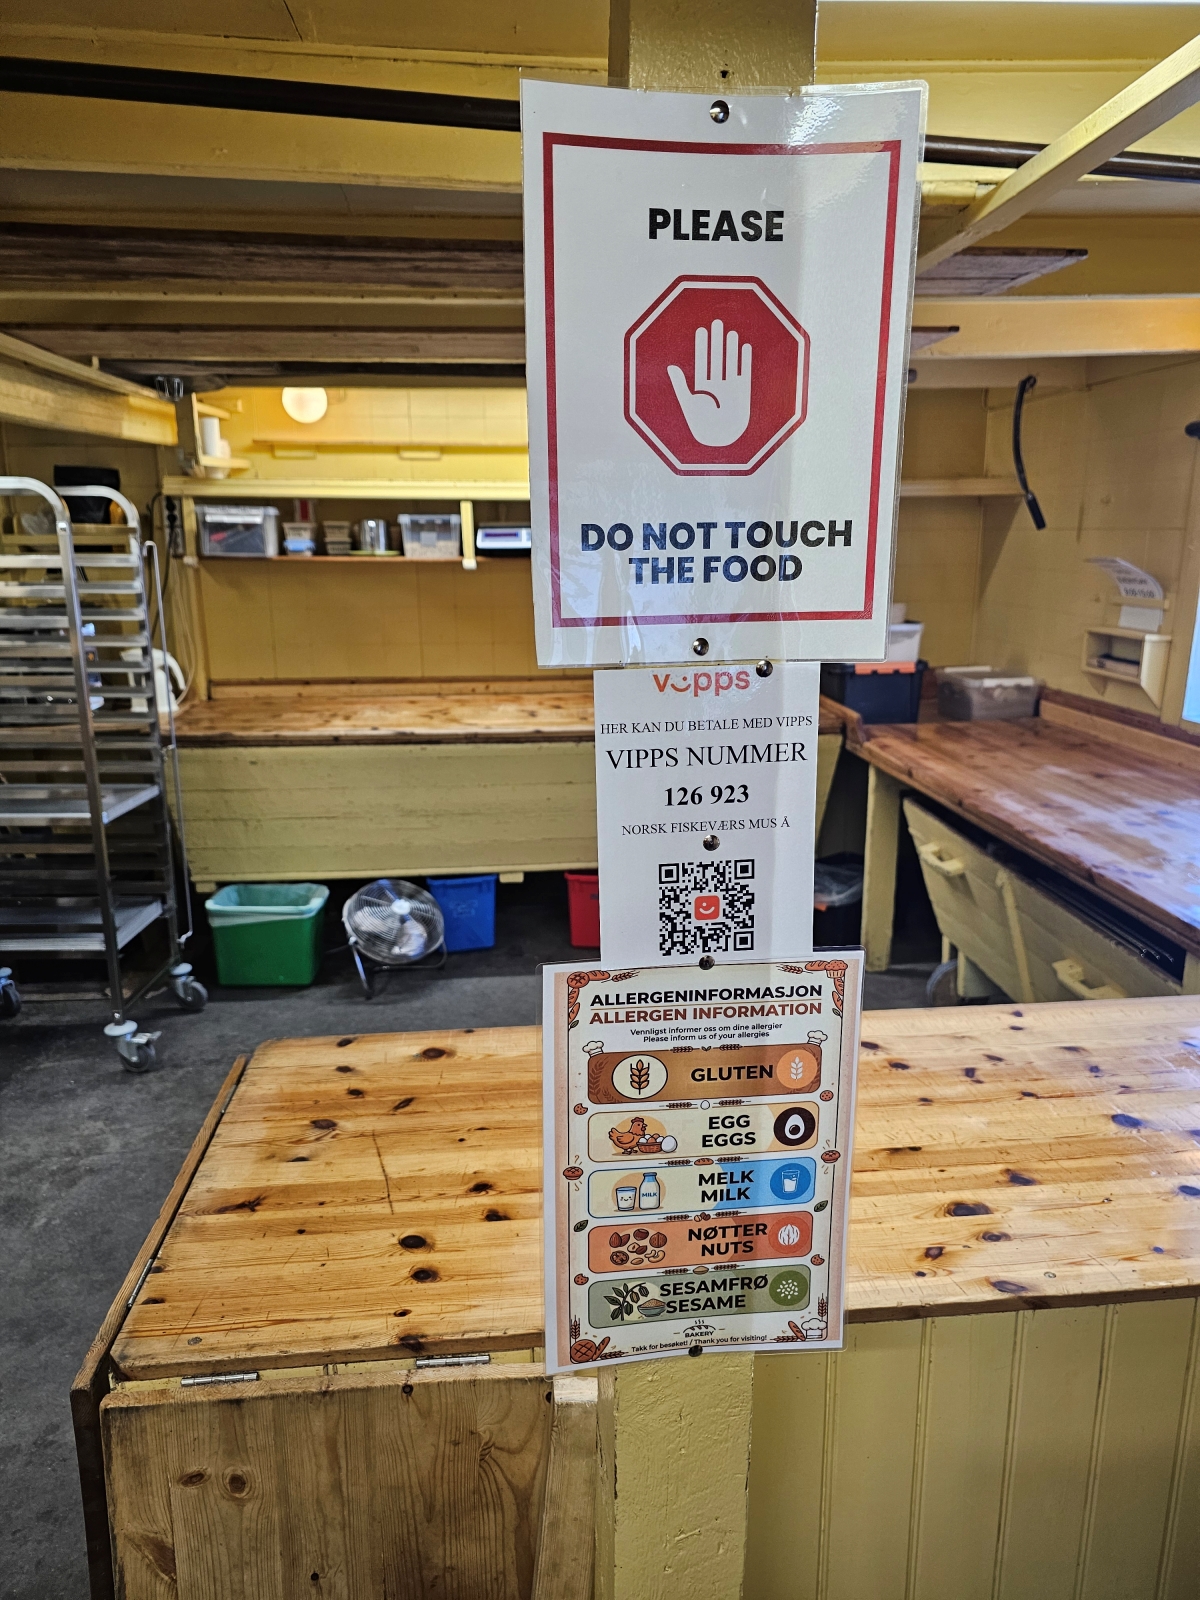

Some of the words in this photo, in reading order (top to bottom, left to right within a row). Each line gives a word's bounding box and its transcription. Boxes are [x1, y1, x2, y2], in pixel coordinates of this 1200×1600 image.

[649, 208, 784, 241] PLEASE
[581, 523, 633, 551] DO
[643, 522, 717, 550] NOT
[725, 520, 852, 548] TOUCH
[629, 557, 694, 584] THE
[703, 555, 802, 583] FOOD
[600, 723, 628, 734] HER
[632, 722, 661, 733] KAN
[665, 721, 684, 732] DU
[688, 719, 738, 731] BETALE
[743, 717, 772, 728] MED
[775, 716, 812, 727] VIPPS
[606, 748, 678, 769] VIPPS
[687, 743, 807, 766] NUMMER
[664, 786, 702, 806] 126
[710, 784, 749, 804] 923
[622, 824, 667, 835] NORSK
[671, 820, 745, 833] FISKEVÆRS
[749, 818, 777, 829] MUS
[780, 816, 790, 828] Å
[590, 985, 822, 1007] ALLERGENINFORMASJON
[589, 1008, 686, 1024] ALLERGEN
[693, 1003, 822, 1020] INFORMATION
[630, 1028, 666, 1036] Vennligst
[691, 1065, 773, 1082] GLUTEN
[708, 1115, 750, 1130] EGG
[702, 1132, 756, 1148] EGGS
[698, 1170, 754, 1186] MELK
[701, 1187, 750, 1203] MILK
[688, 1223, 767, 1242] NØTTER
[701, 1240, 754, 1256] NUTS
[660, 1274, 768, 1296] SESAMFRØ
[666, 1295, 746, 1314] SESAME
[660, 1340, 688, 1349] besøket!
